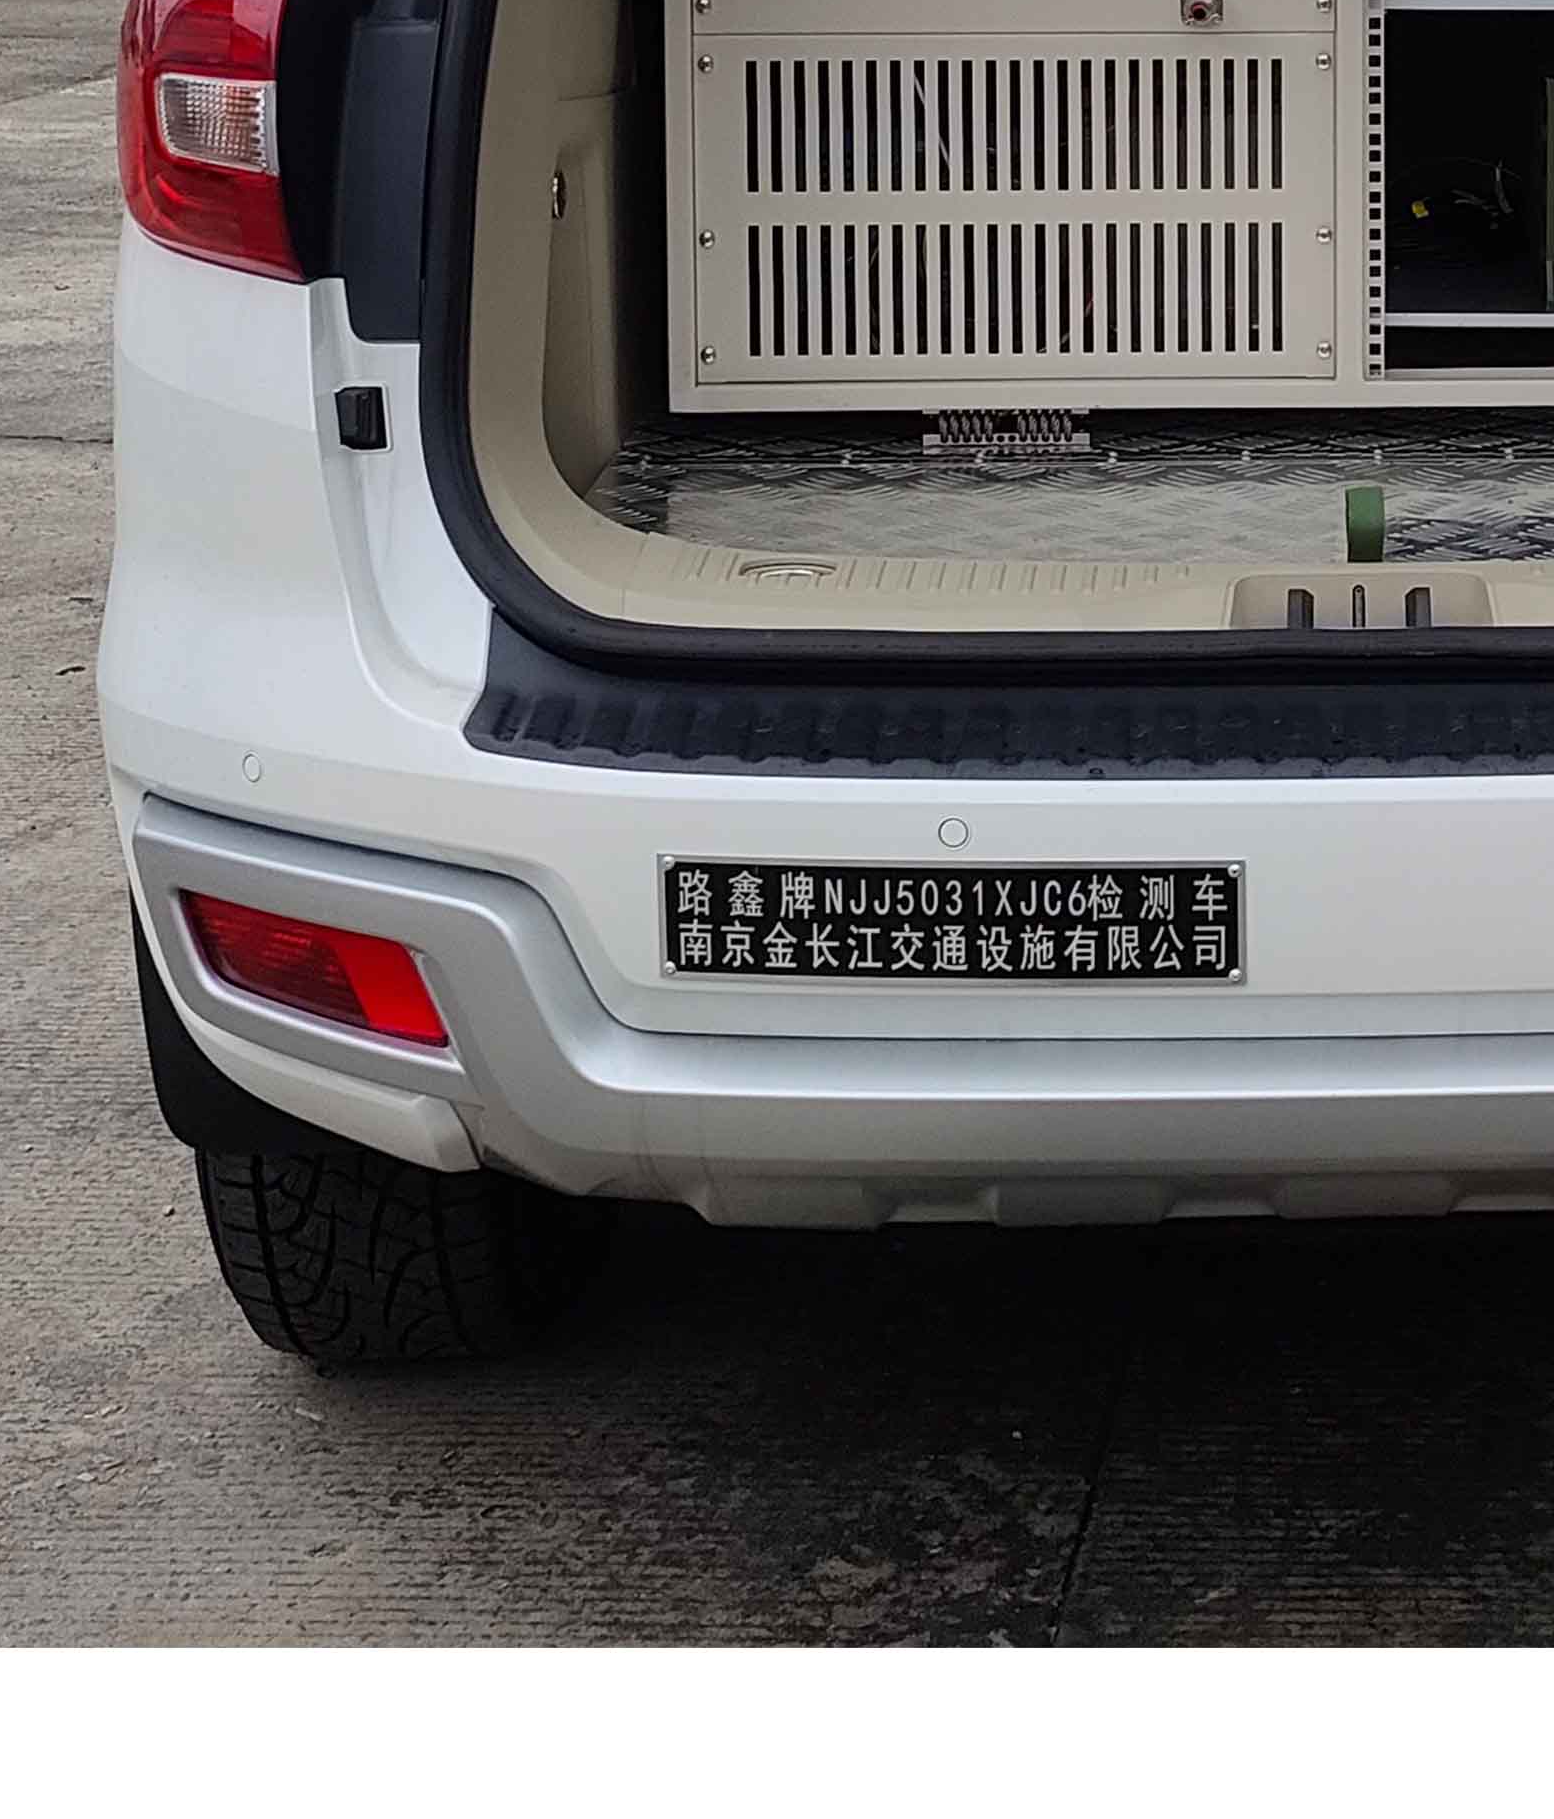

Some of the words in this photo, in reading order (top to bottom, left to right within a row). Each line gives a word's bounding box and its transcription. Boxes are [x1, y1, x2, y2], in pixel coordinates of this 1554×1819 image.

[678, 919, 1228, 972] 南京金长江交通设施有限公司
